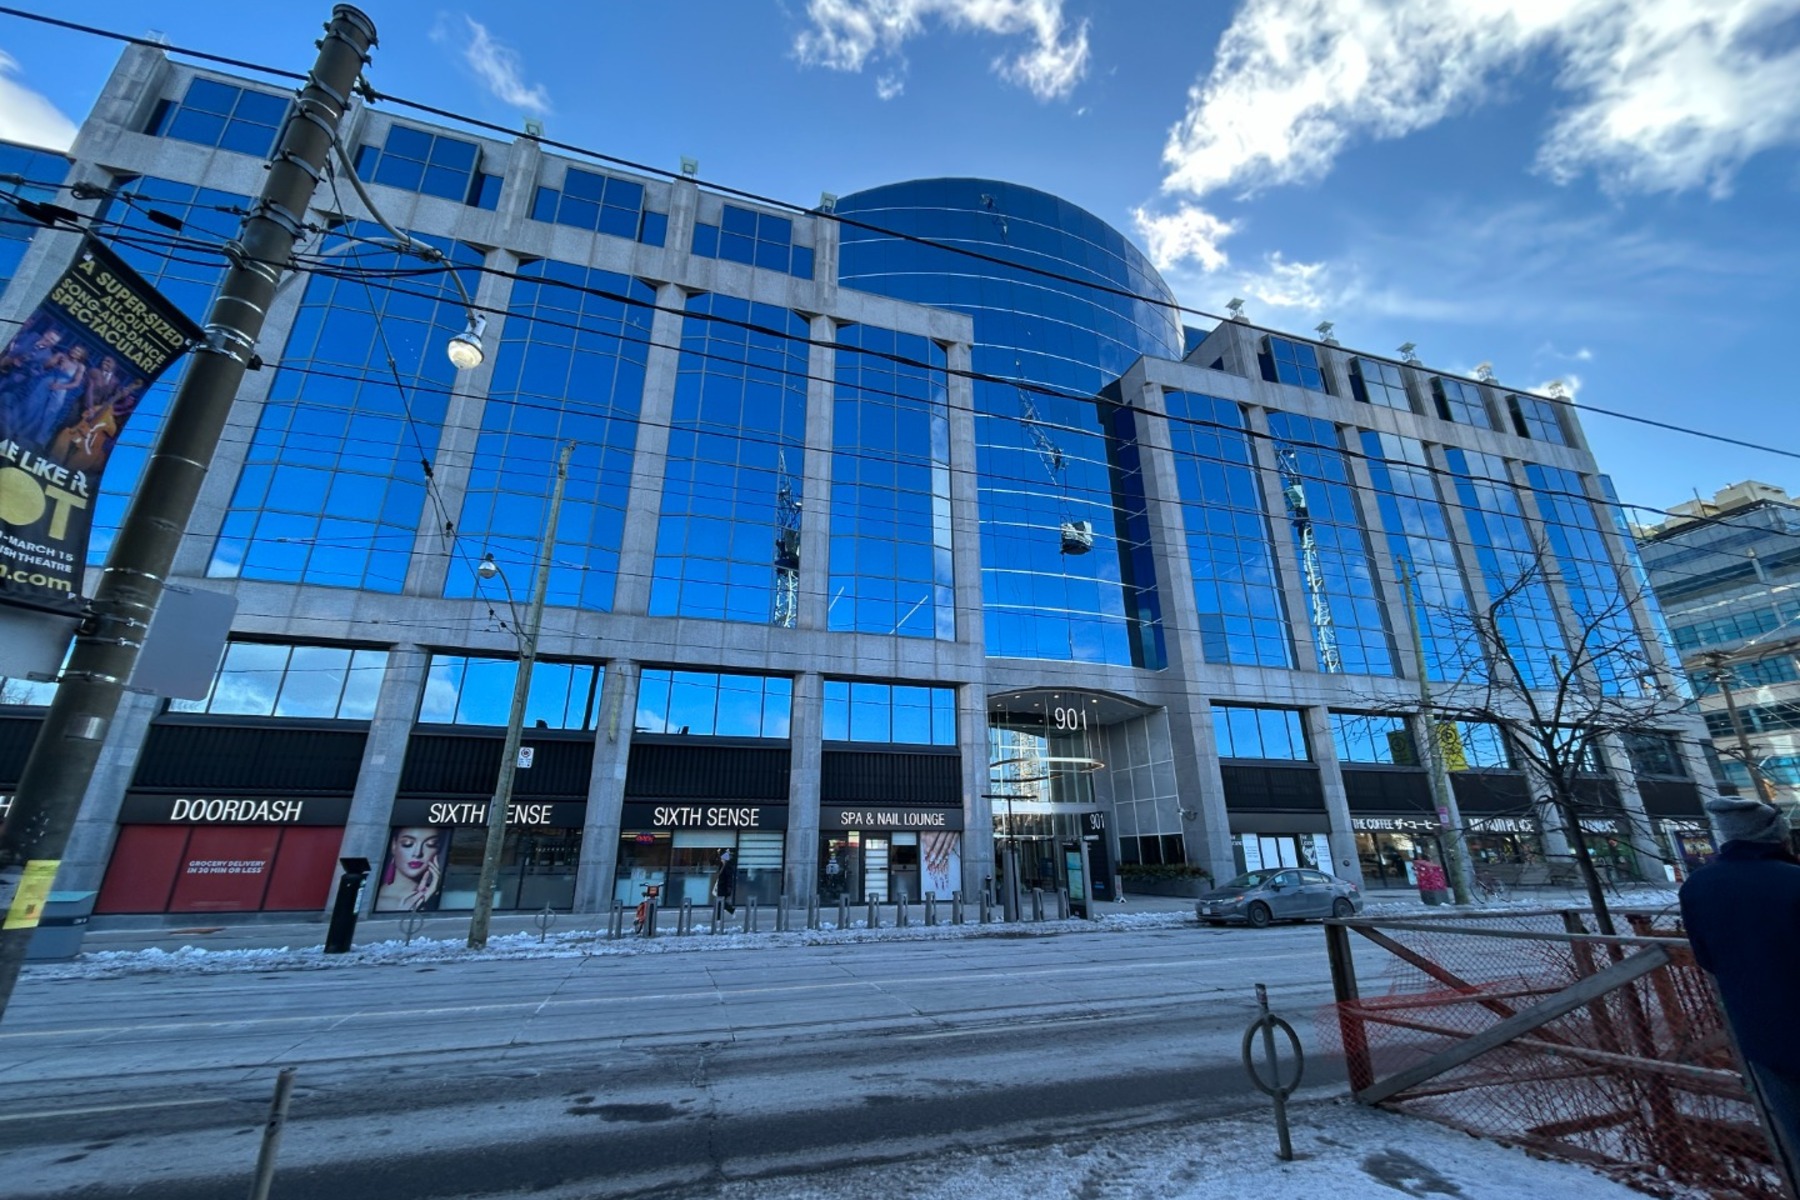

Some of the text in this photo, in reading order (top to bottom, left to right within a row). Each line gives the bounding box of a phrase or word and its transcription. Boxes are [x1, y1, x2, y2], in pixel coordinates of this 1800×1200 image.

[79, 260, 96, 276] A
[62, 278, 167, 365] SONG-AND-DANCE
[100, 295, 149, 335] ALL-OUT
[52, 287, 159, 374] SPECTACULAR!
[0, 530, 74, 562] -MARCH 15
[18, 551, 73, 574] THEATRE
[1054, 706, 1087, 731] 901
[170, 799, 303, 822] DOORDASH
[428, 803, 553, 825] SIXTH ENSE
[653, 807, 760, 827] SIXTH SENSE
[841, 811, 946, 827] SPA & NAIL LOUNGE
[1089, 813, 1105, 830] 901
